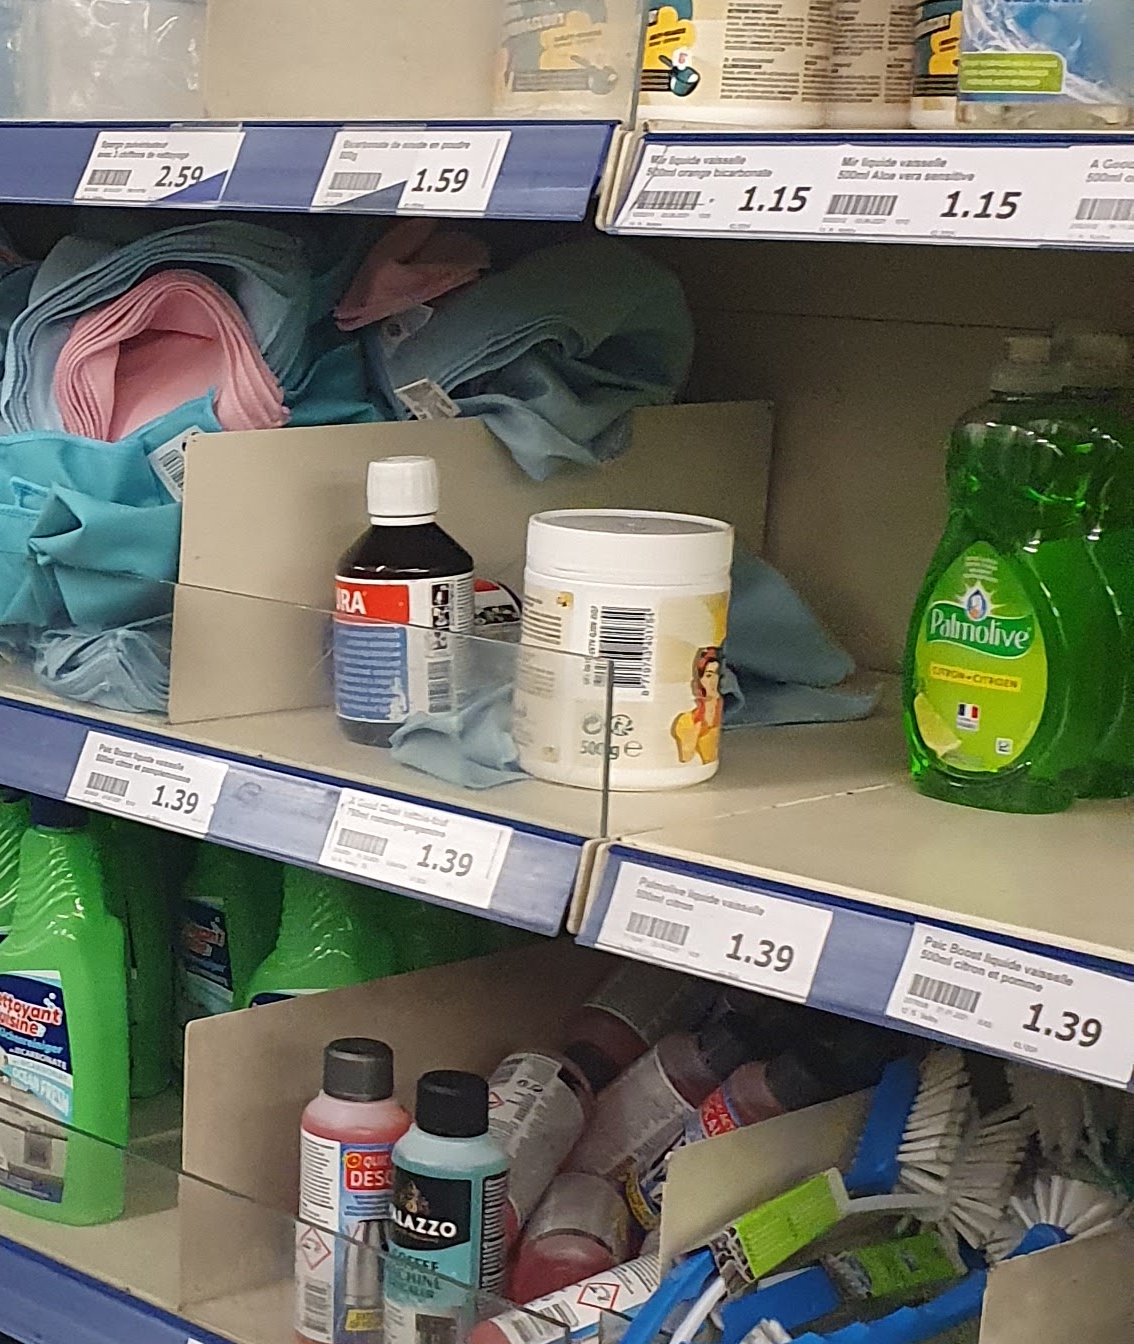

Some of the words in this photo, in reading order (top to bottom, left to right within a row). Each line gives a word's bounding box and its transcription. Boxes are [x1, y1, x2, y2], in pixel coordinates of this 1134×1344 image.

[154, 166, 204, 188] 2.59
[411, 168, 469, 193] 1.59
[738, 186, 812, 212] 1.15
[940, 191, 1022, 219] 1.15
[929, 607, 1031, 650] Palmolive
[152, 785, 199, 814] 1.39
[417, 844, 473, 877] 1.39
[726, 933, 794, 972] 1.39
[924, 935, 947, 952] Paic
[949, 943, 983, 961] Boost
[984, 952, 1021, 972] liquide
[1024, 965, 1074, 986] vaisselle
[953, 959, 985, 976] citron
[987, 969, 999, 981] et
[1000, 973, 1043, 993] pomme
[1023, 1003, 1102, 1047] 1.39
